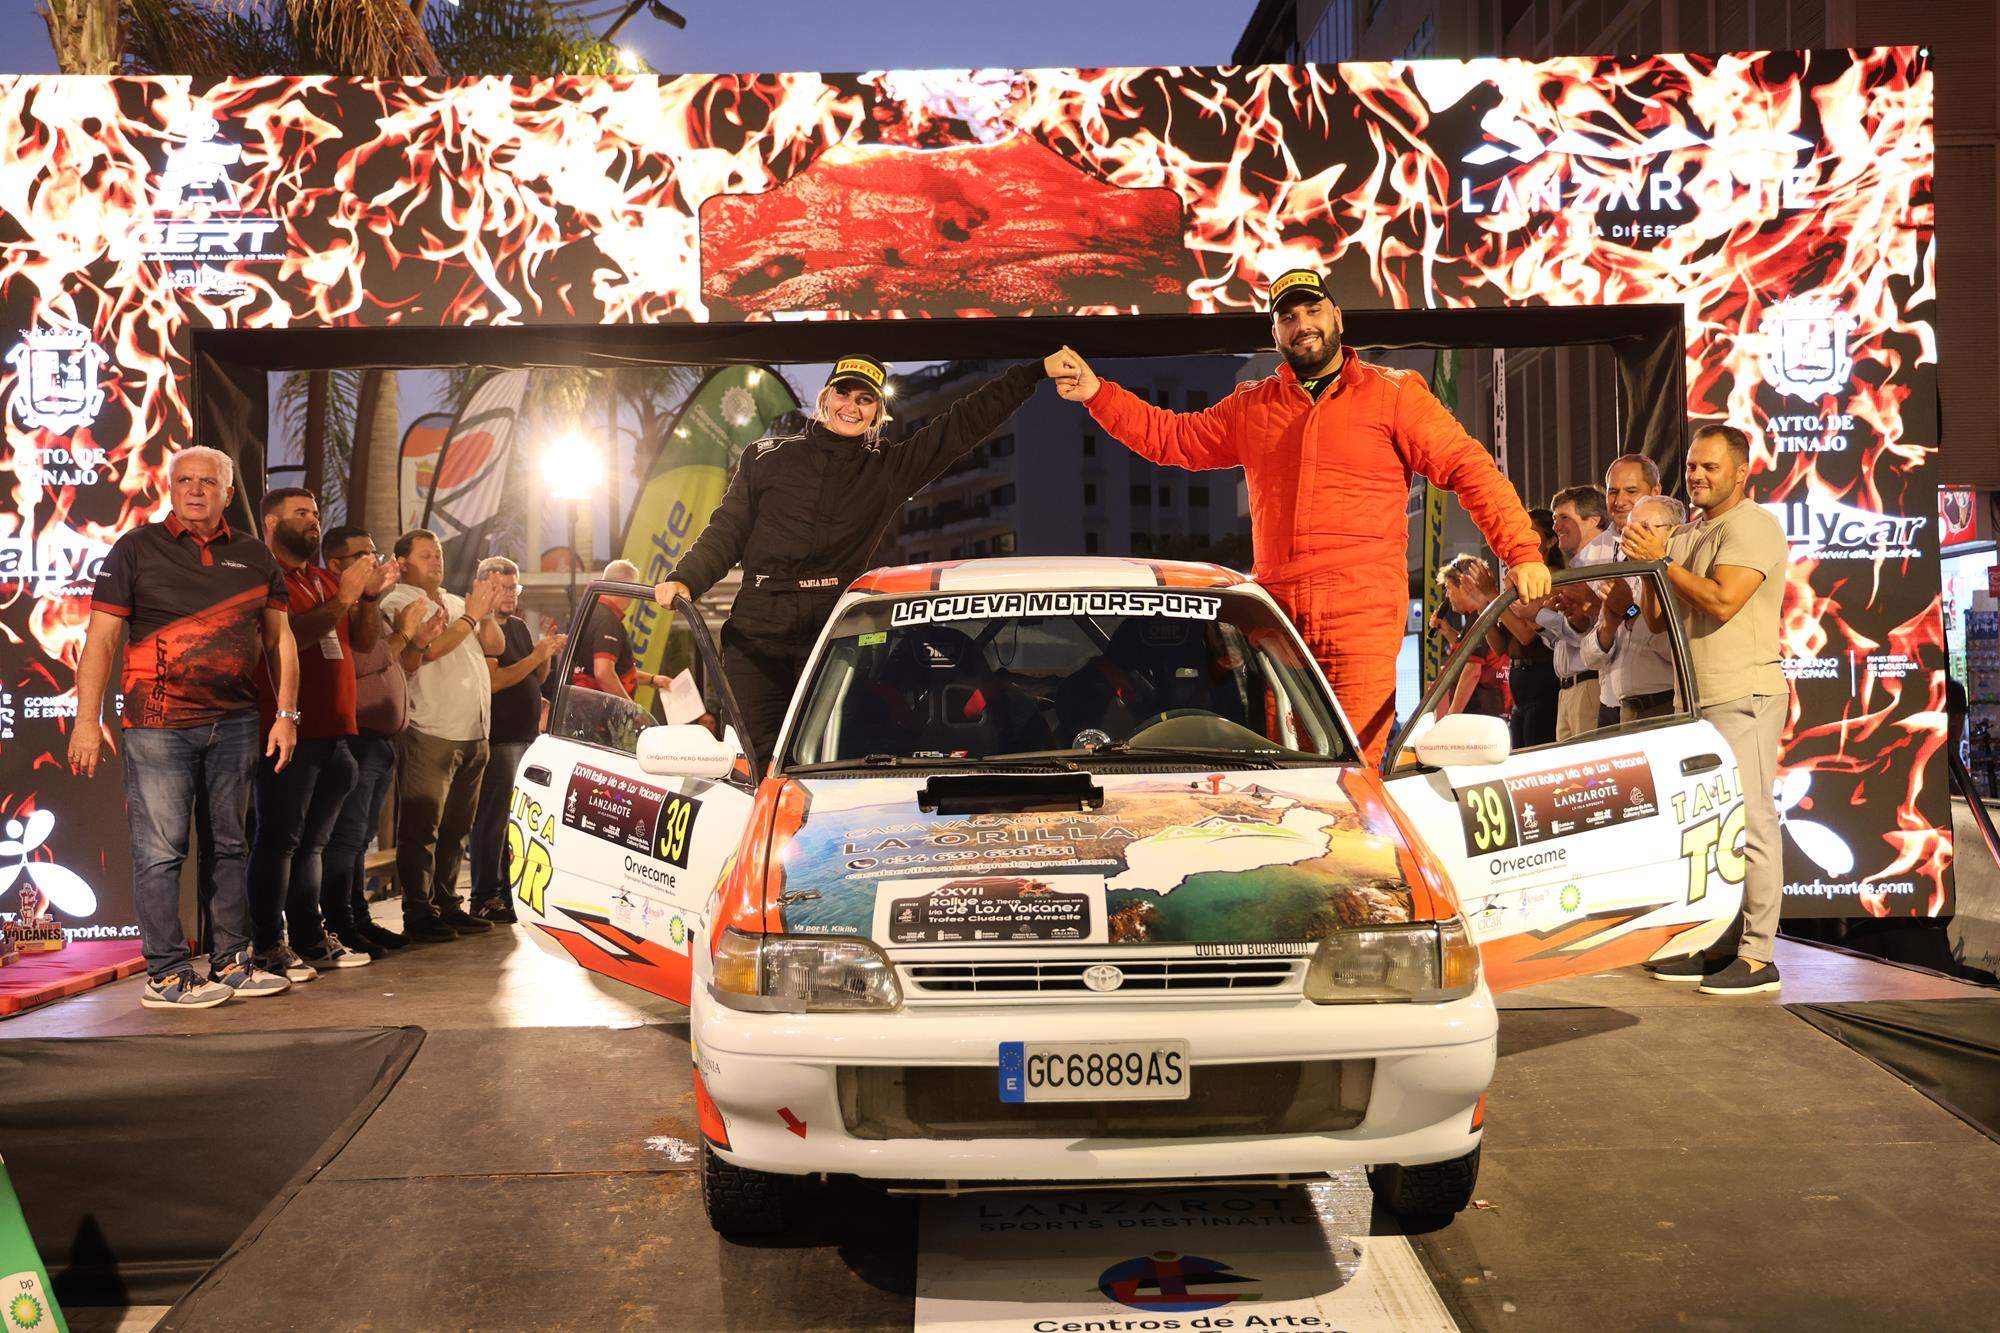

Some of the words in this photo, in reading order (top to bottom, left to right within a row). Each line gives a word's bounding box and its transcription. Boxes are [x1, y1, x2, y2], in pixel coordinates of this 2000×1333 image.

[1766, 416, 1823, 432] AYTO.
[1827, 415, 1854, 431] DE
[1775, 436, 1847, 453] TINAJO
[1785, 502, 1927, 547] llycar
[799, 579, 821, 588] TANIA
[821, 577, 839, 587] BRITO
[891, 599, 928, 626] LA
[931, 592, 1023, 620] CUEVA
[1028, 591, 1222, 621] MOTORSPORT
[24, 708, 41, 719] DE
[1583, 766, 1594, 776] de
[618, 779, 627, 790] de
[1554, 785, 1618, 808] LANZAROTE
[1671, 766, 1744, 824] TALL
[589, 795, 632, 818] LANZAROTE
[1467, 786, 1508, 850] 39
[661, 798, 692, 862] 39
[845, 822, 928, 839] CASA
[843, 837, 911, 856] LA
[932, 826, 1138, 846] ORILLA
[1490, 848, 1566, 876] Orvecame
[624, 855, 676, 888] Orvecame
[931, 887, 984, 897] XXVII
[929, 897, 979, 908] Rallye
[929, 908, 943, 916] Isla
[946, 904, 969, 915] de
[975, 905, 1001, 914] Los
[1009, 903, 1081, 914] Volcanes
[968, 914, 1012, 922] Ciudad
[4, 928, 62, 944] VOLCANES
[794, 923, 804, 932] Va
[805, 925, 821, 933] por
[831, 925, 858, 933] Kikillo
[1027, 1051, 1183, 1088] GC6889AS
[1006, 1078, 1017, 1090] E
[978, 1199, 1290, 1218] LANZAROT
[979, 1219, 1104, 1232] SPORTS
[1118, 1215, 1310, 1229] DESTINATIO
[20, 1279, 34, 1290] bp
[1033, 1317, 1181, 1333] Centros
[1190, 1313, 1234, 1329] de
[1246, 1312, 1332, 1330] Arte,
